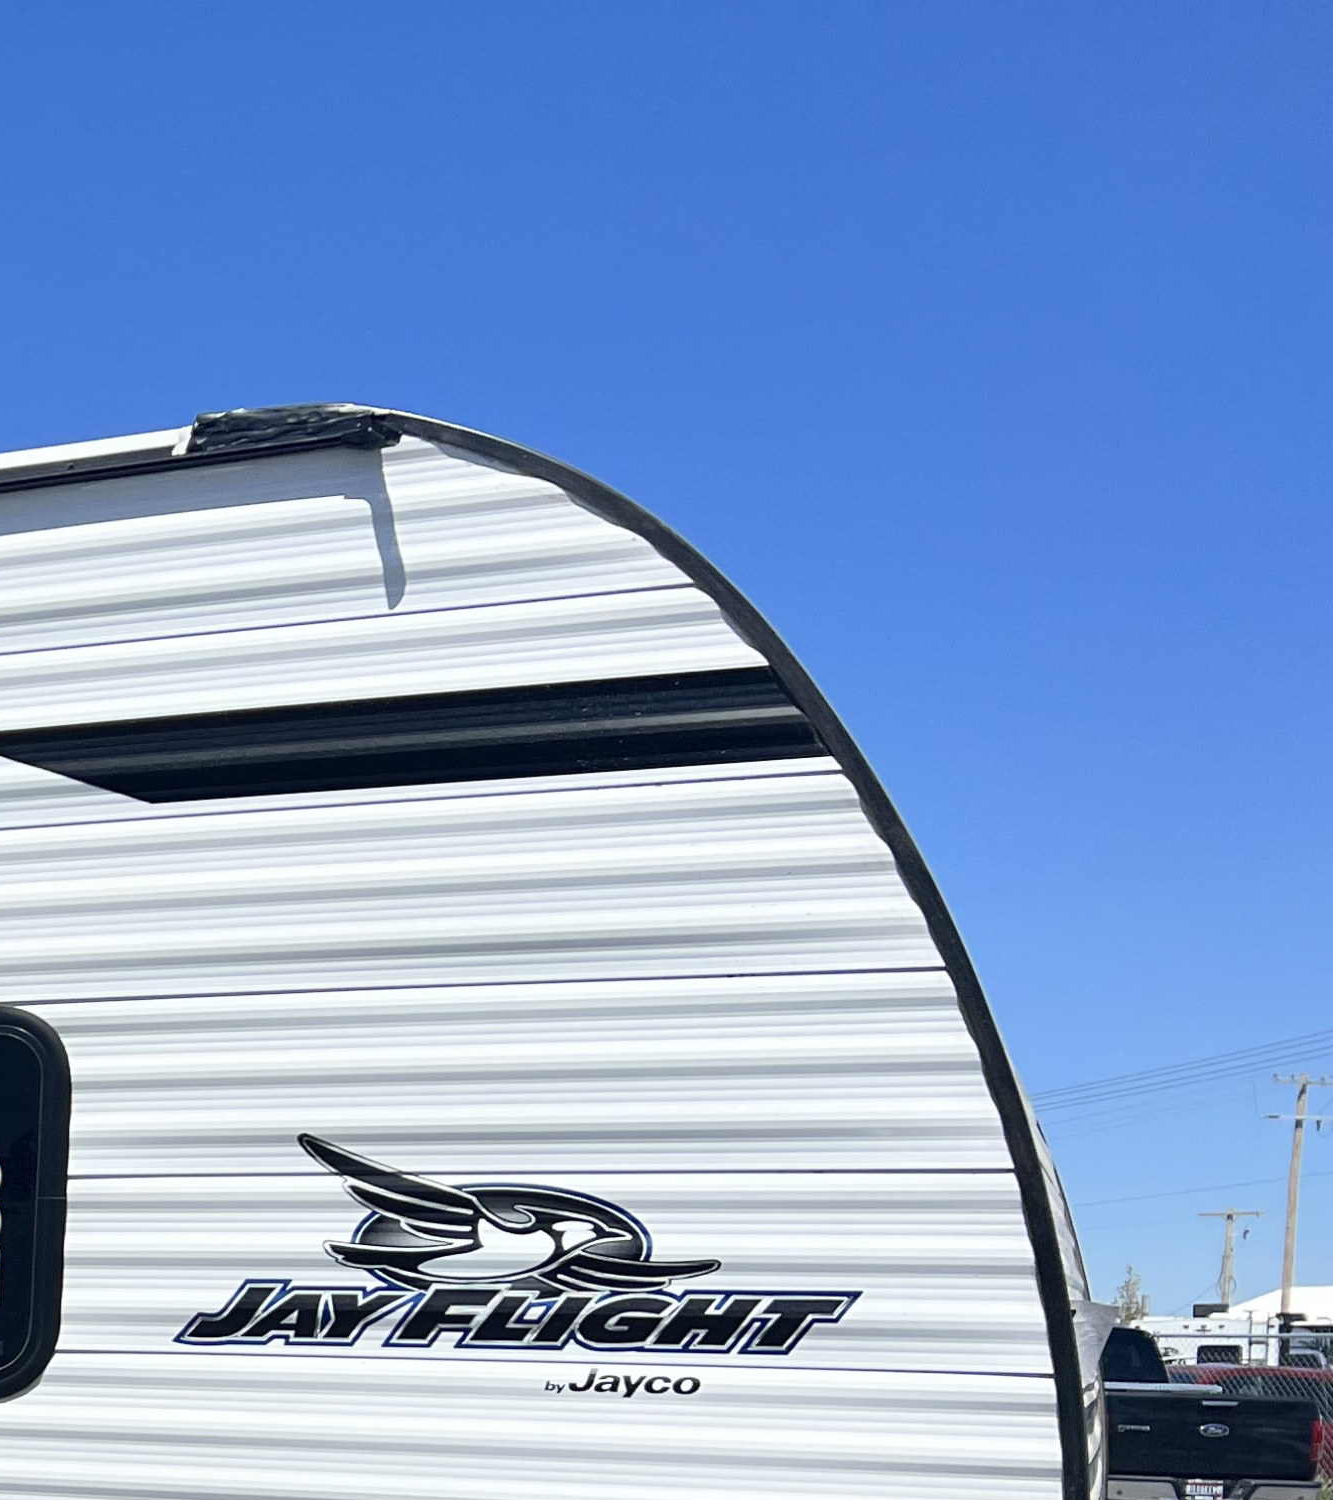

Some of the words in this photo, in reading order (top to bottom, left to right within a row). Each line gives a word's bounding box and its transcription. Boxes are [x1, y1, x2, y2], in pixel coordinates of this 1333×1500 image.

[173, 1279, 407, 1347] JAY
[381, 1283, 863, 1355] FLIGHT
[544, 1381, 566, 1394] by
[568, 1368, 701, 1398] Jayco
